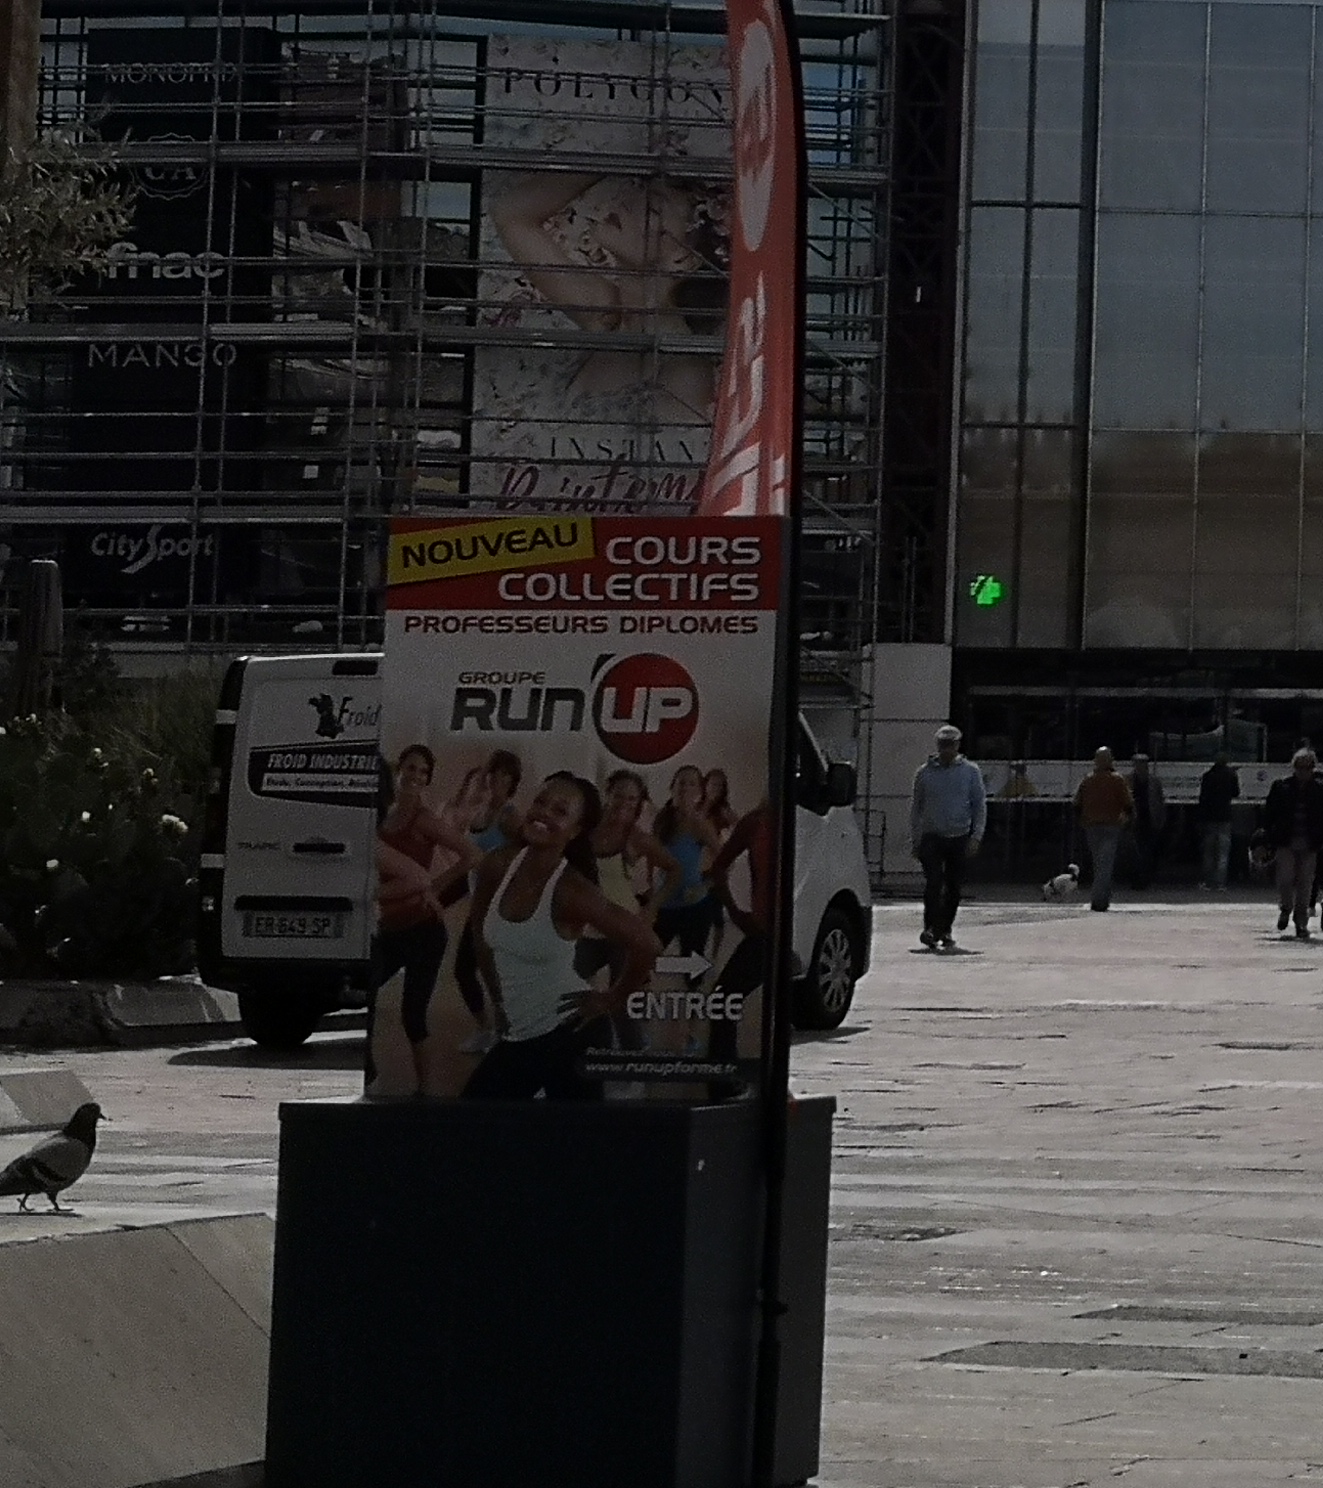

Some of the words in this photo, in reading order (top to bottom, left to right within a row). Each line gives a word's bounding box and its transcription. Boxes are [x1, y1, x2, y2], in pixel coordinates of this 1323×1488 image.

[88, 343, 237, 368] MANGO
[402, 522, 579, 569] NOUVEAU
[605, 536, 762, 566] COURS
[499, 572, 761, 602] COLLECTIFS
[404, 615, 608, 634] PROFESSEURS
[619, 615, 759, 634] DIPLOMES
[458, 671, 546, 685] GROUPE
[600, 686, 694, 733] UP
[267, 753, 307, 770] FROID
[626, 985, 744, 1020] ENTRÉE
